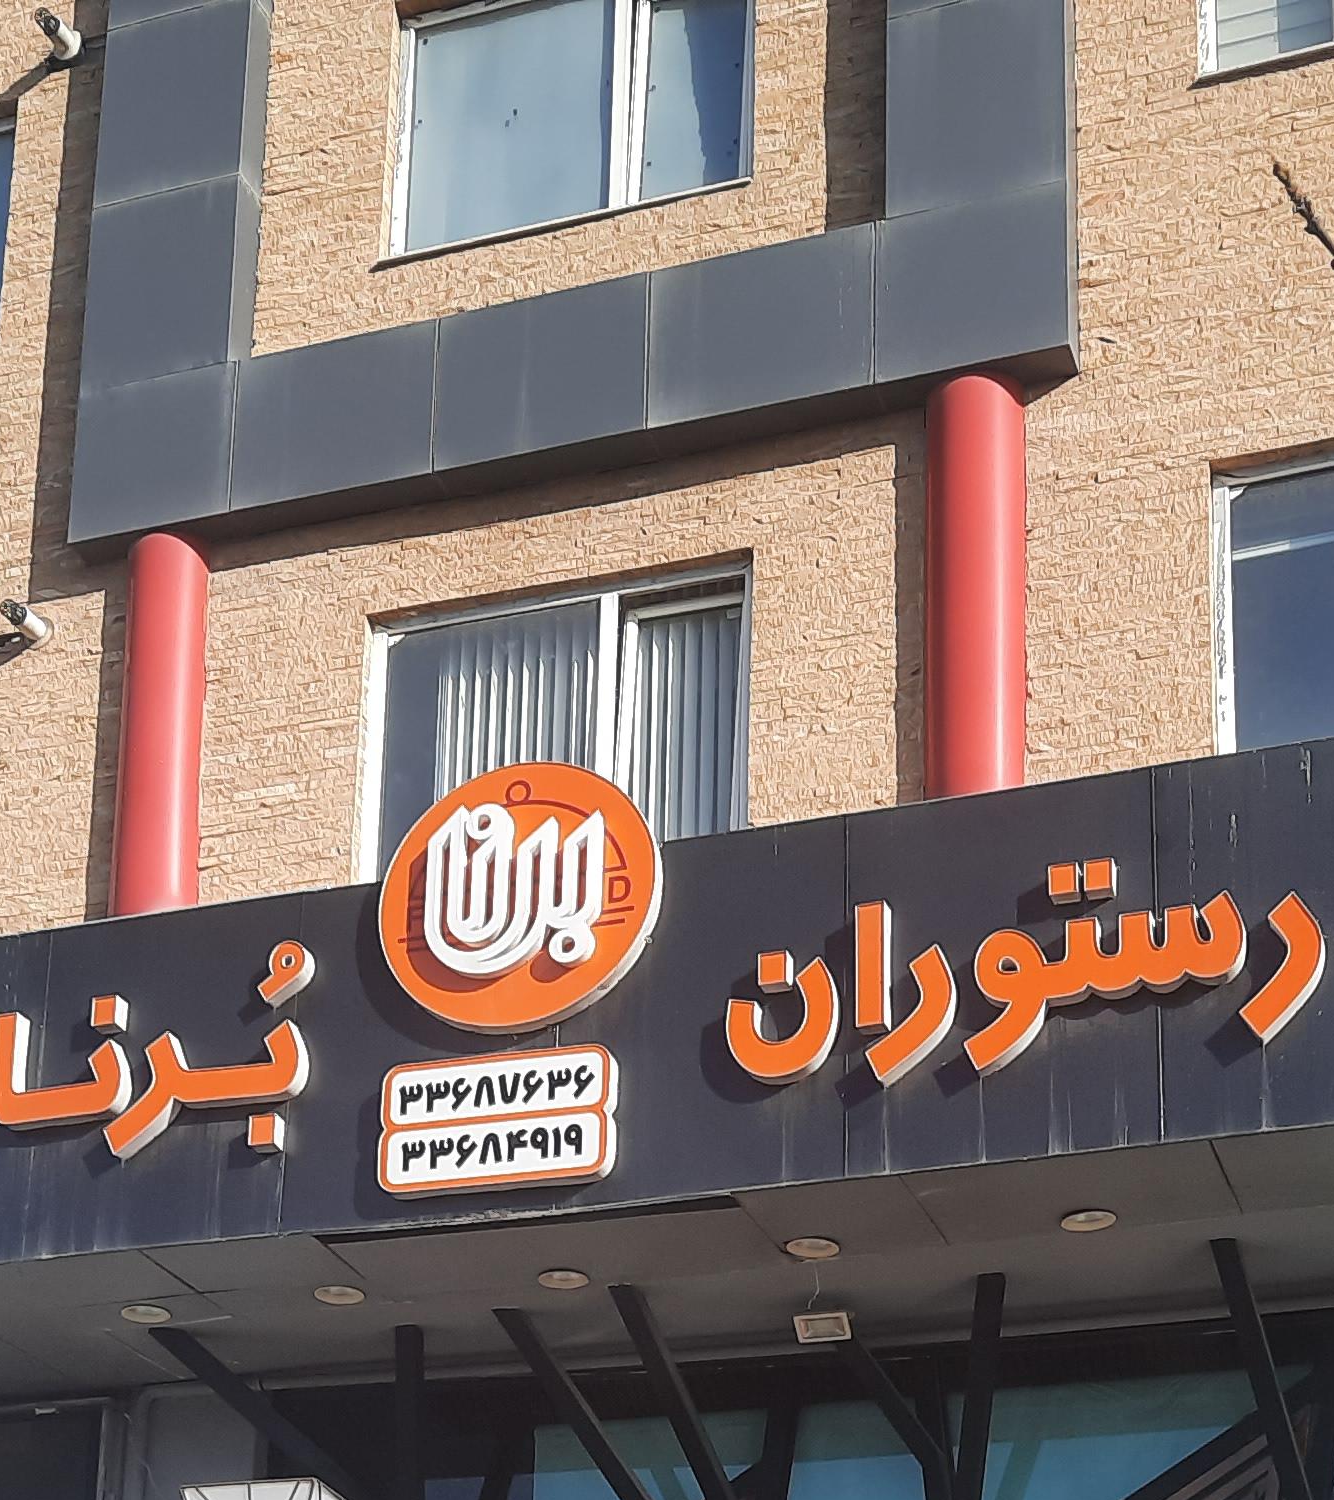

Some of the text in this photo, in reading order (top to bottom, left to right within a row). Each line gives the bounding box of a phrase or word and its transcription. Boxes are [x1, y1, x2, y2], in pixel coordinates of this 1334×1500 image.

[725, 856, 1323, 1080] رستوران
[398, 1064, 596, 1116] ۳۳۶۸۷۶۳۶
[400, 1122, 584, 1173] ۳۳۶۸۴۹۱۹
